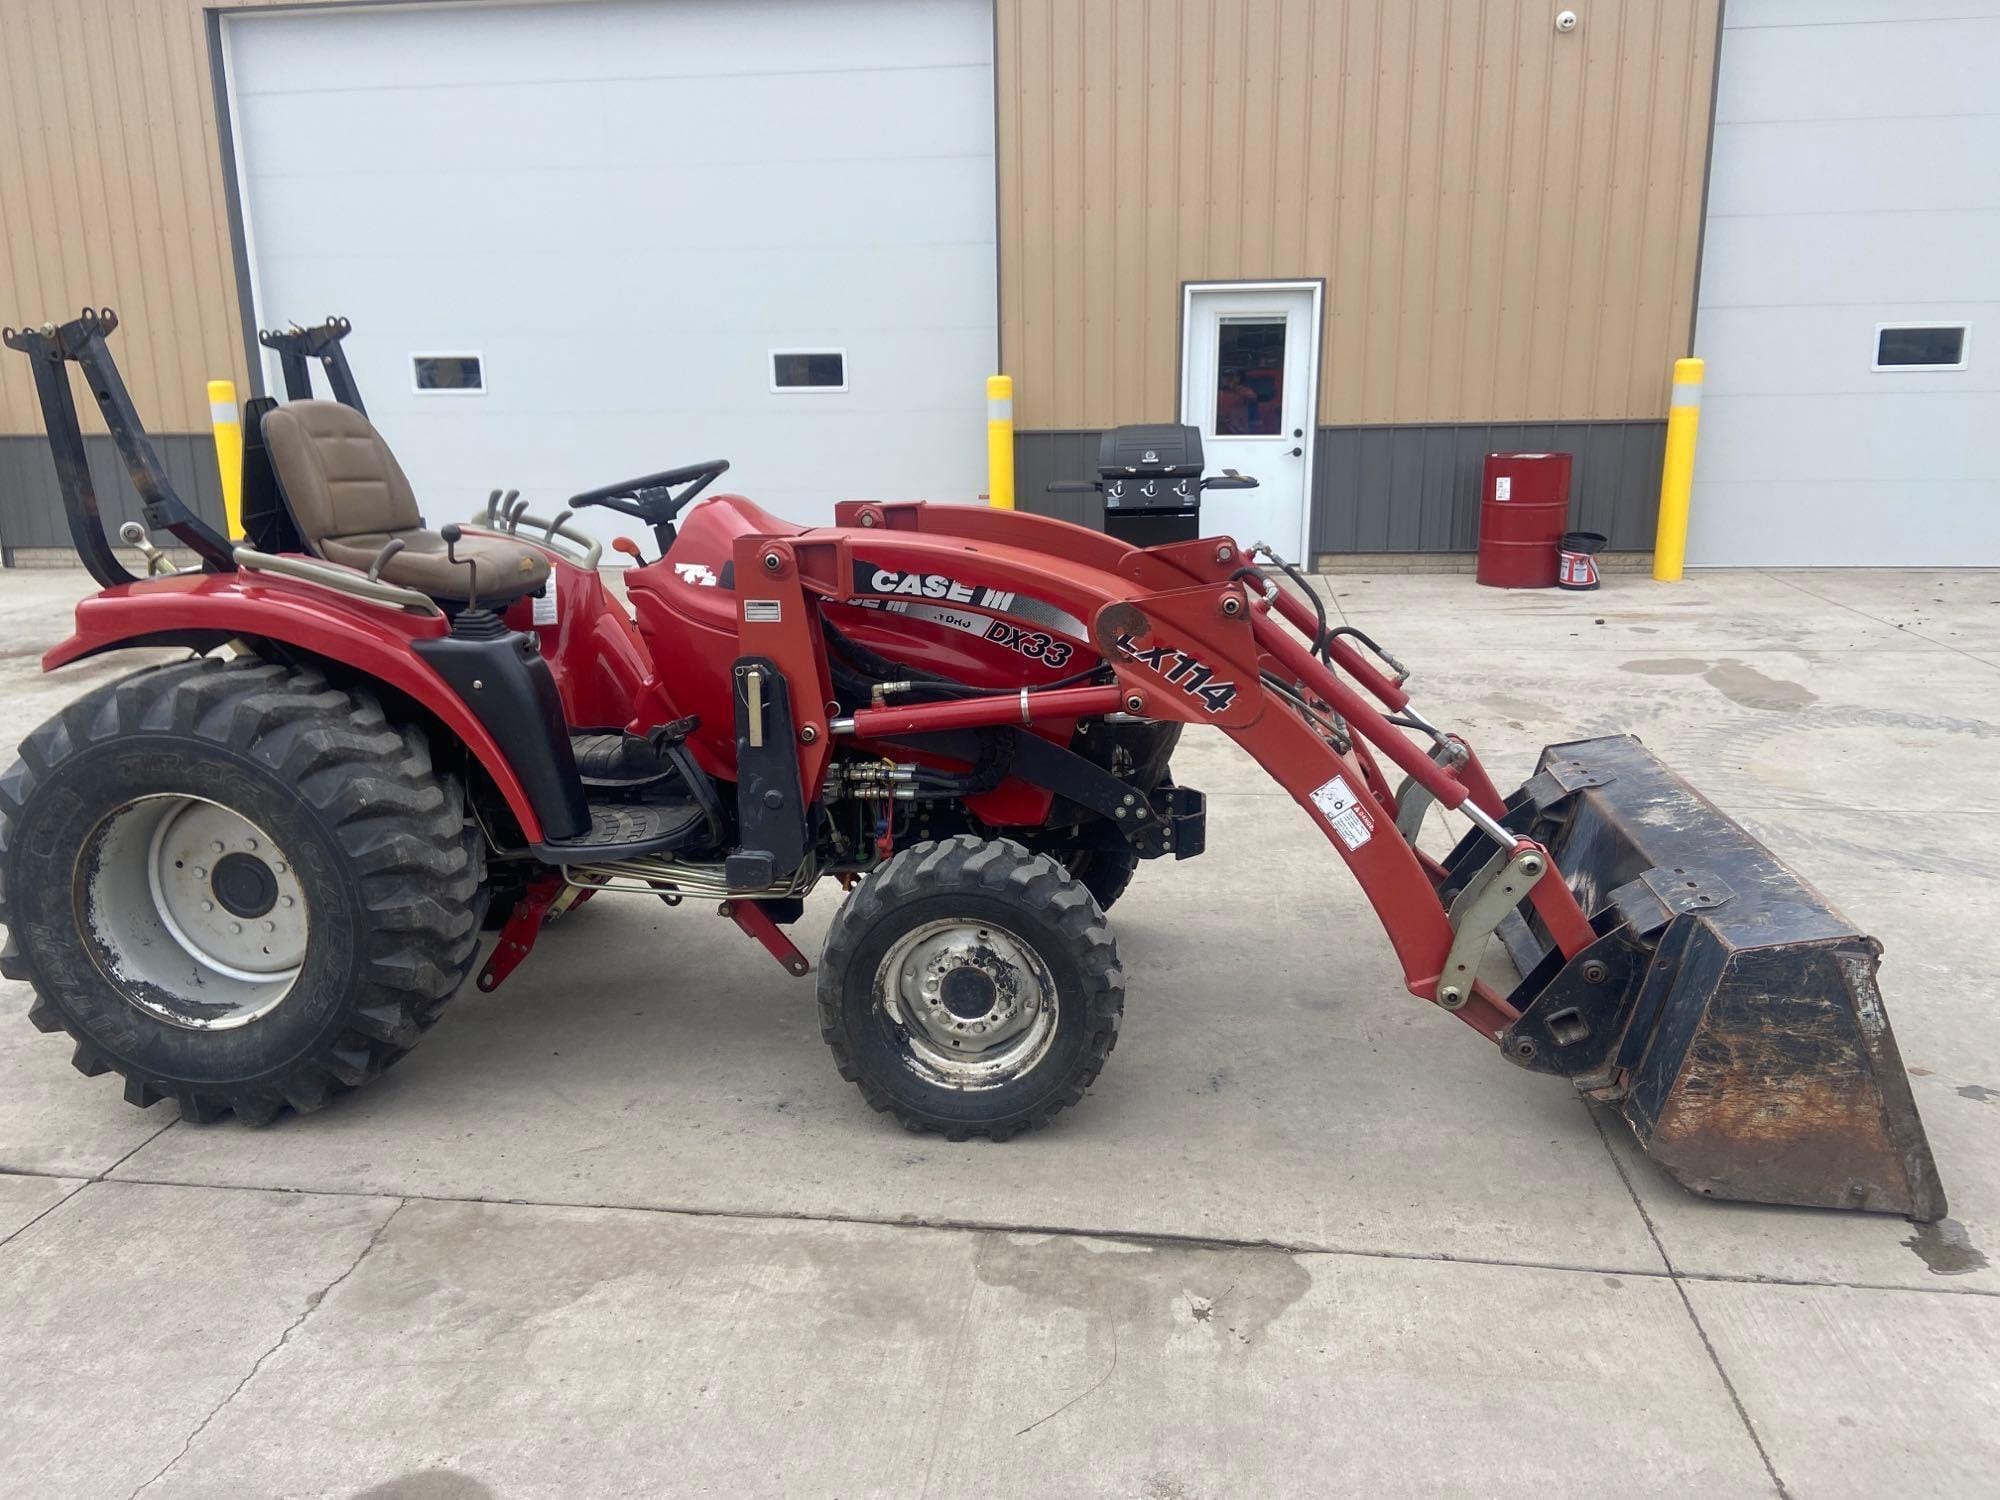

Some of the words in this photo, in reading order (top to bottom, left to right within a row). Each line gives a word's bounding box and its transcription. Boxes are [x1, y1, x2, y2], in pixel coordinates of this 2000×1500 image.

[871, 569, 974, 603] CASE
[983, 620, 1073, 669] DX33
[1115, 633, 1237, 713] LX114
